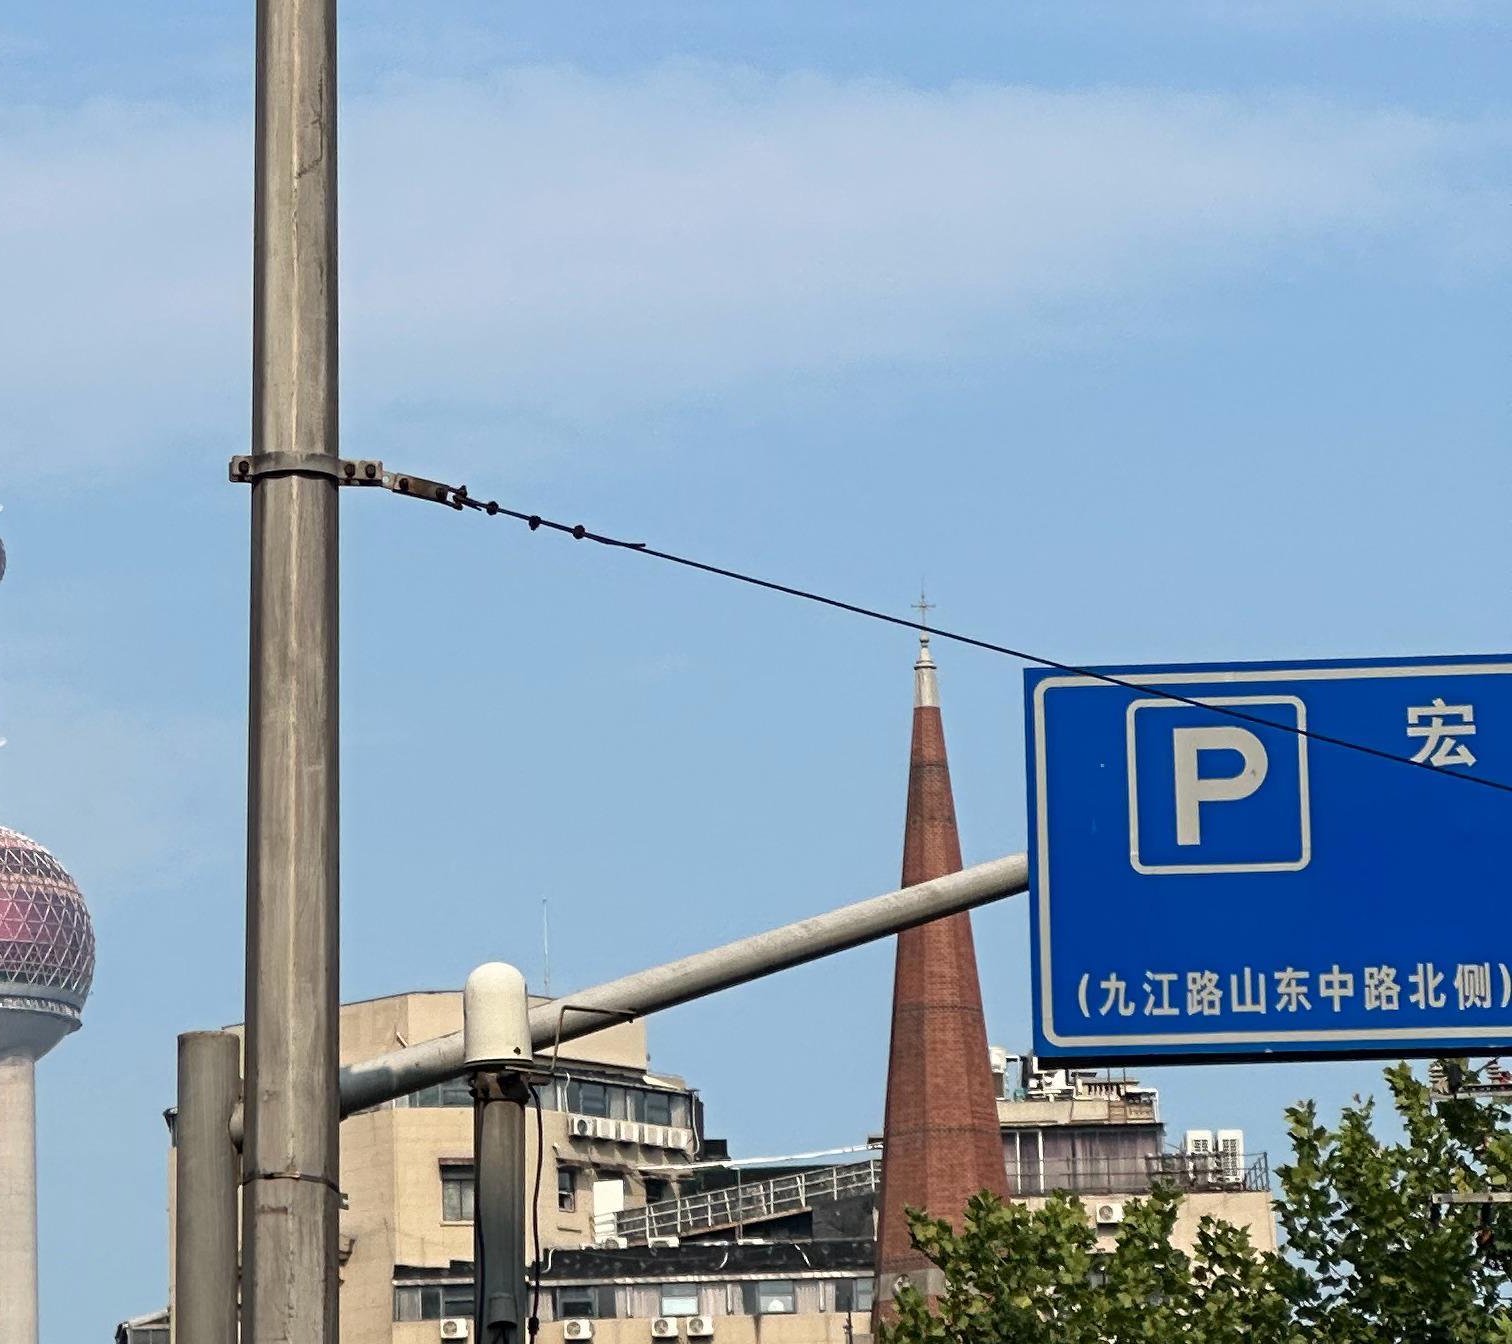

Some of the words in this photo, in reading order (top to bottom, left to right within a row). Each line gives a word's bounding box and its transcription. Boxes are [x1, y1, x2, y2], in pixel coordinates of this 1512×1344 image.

[1406, 697, 1478, 768] 宏
[1173, 726, 1269, 845] P
[1077, 961, 1512, 1018] (九江路山东中路北侧)
